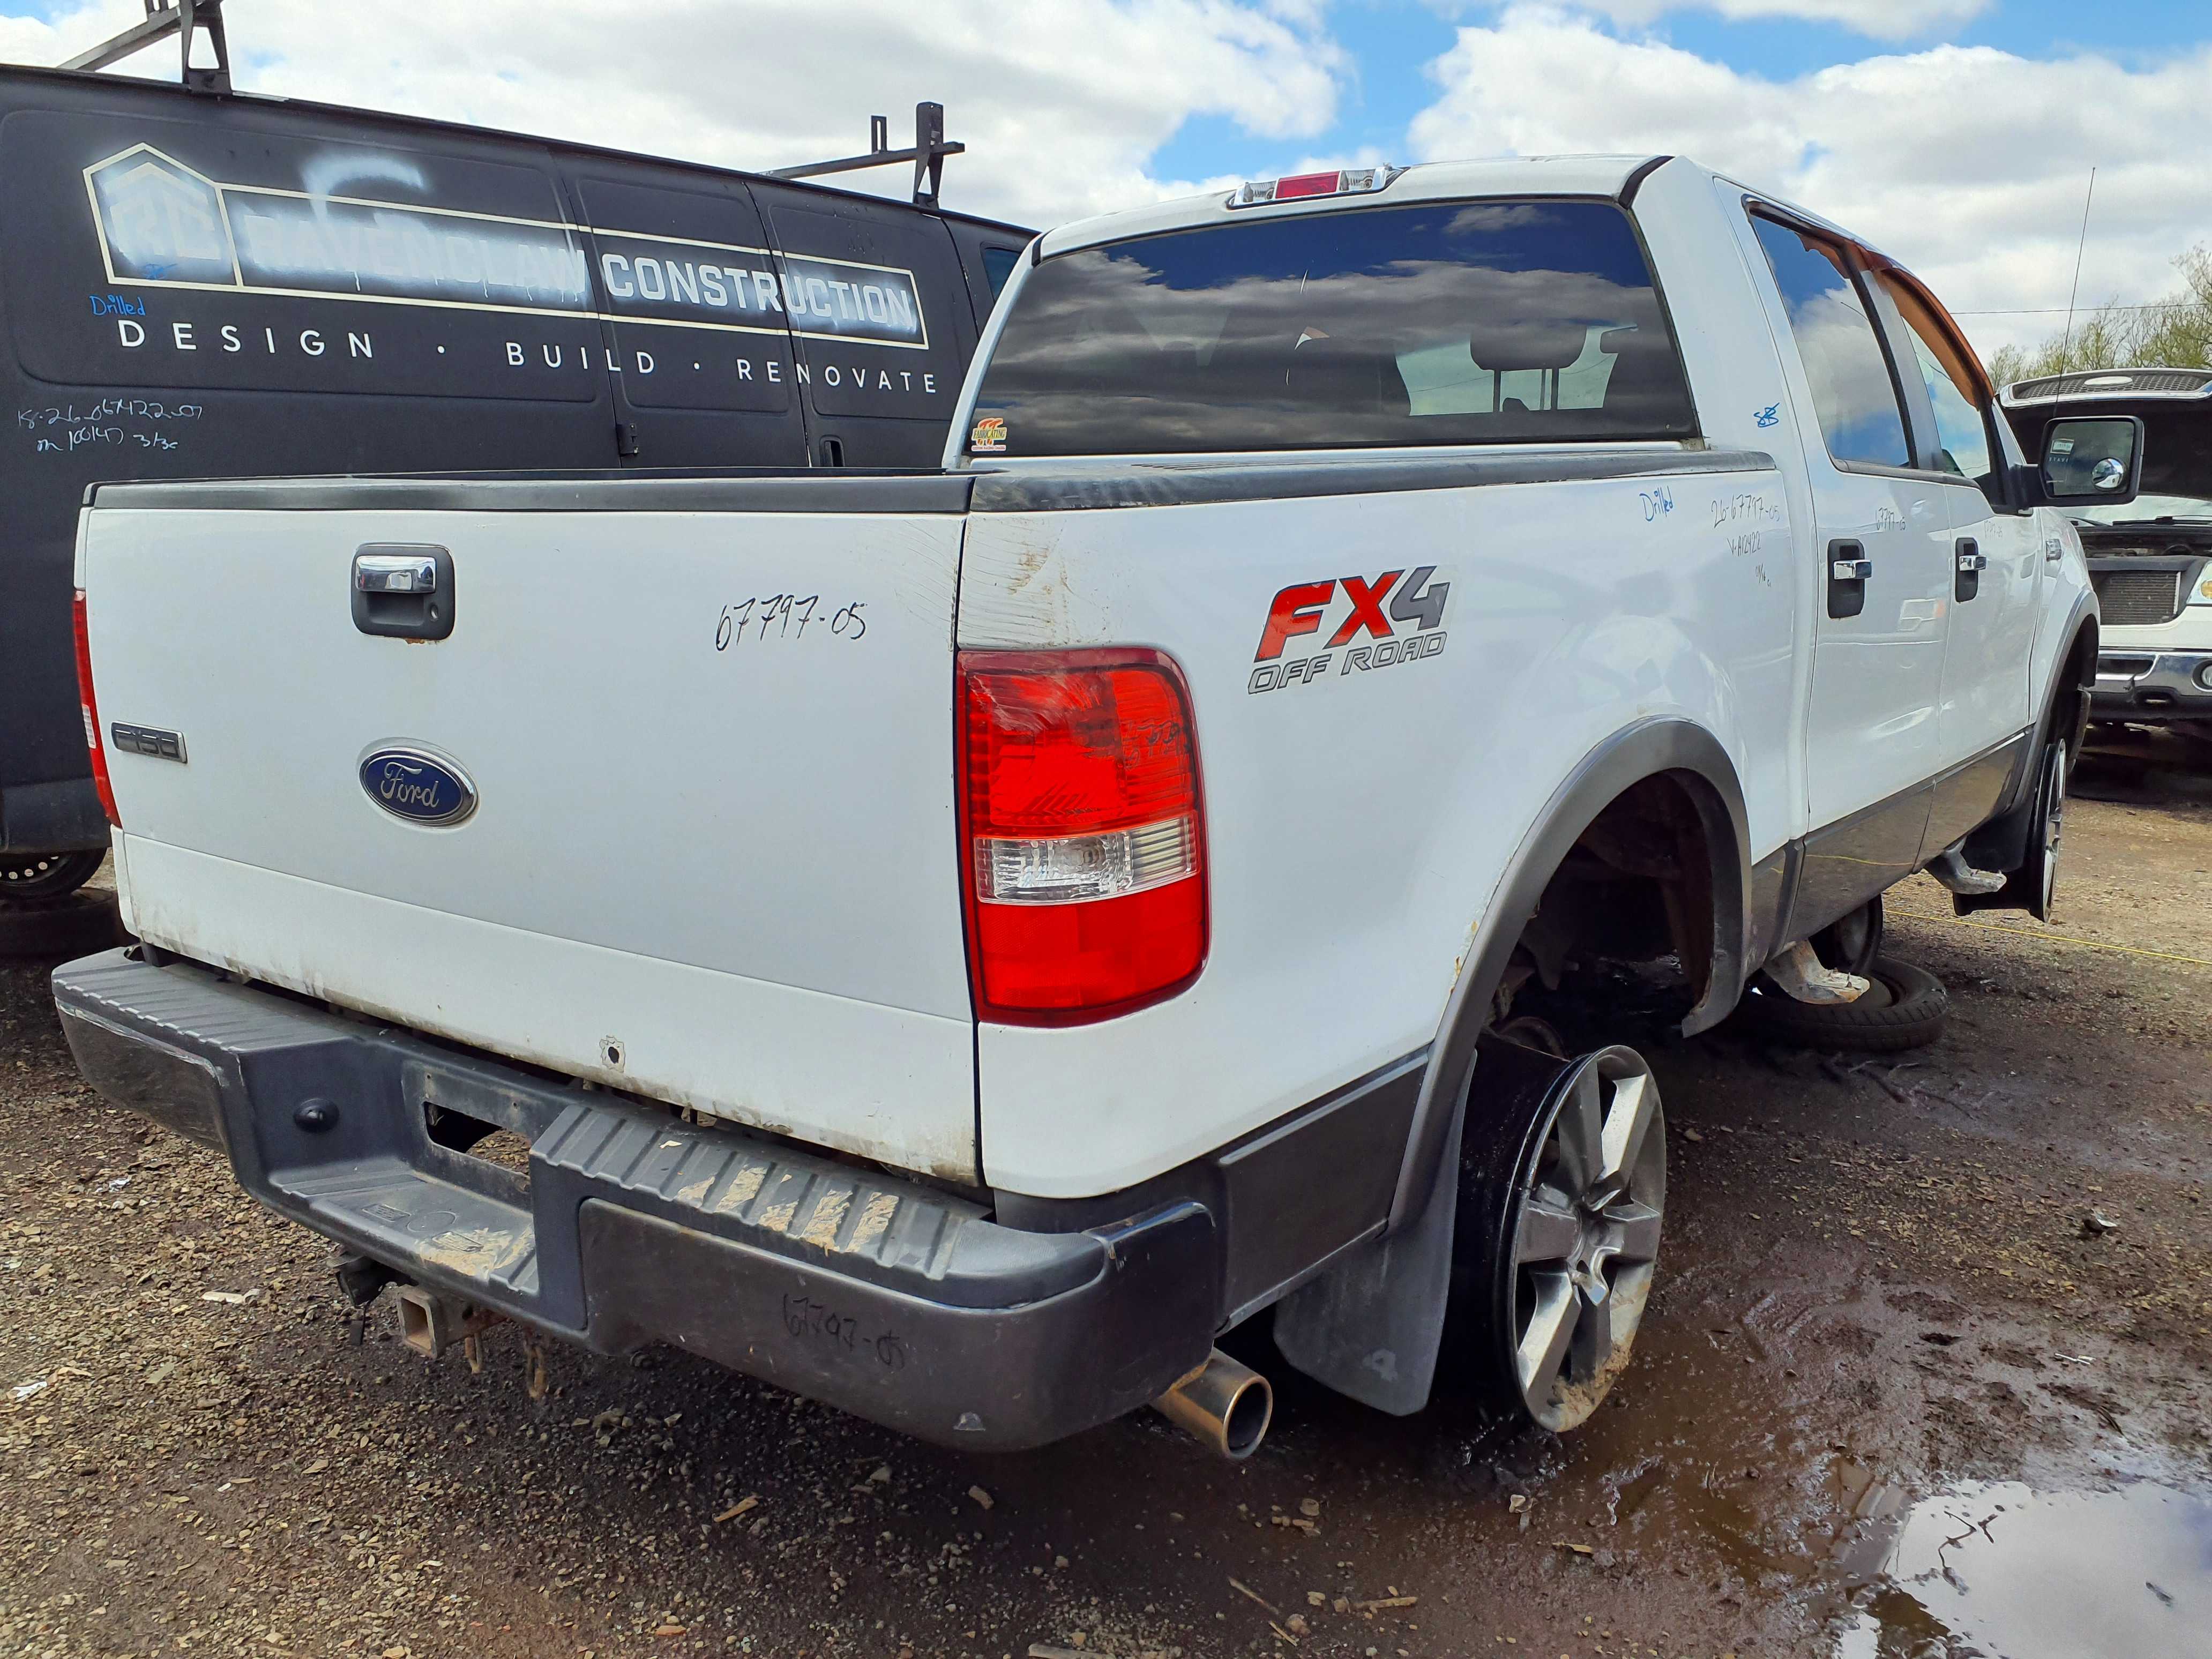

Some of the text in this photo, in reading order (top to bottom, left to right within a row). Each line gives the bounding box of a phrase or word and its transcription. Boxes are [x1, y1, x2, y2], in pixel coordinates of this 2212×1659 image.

[89, 294, 146, 316] Drilled
[602, 253, 917, 327] CONSTRUCTION
[118, 319, 937, 393] DESIGN BUILD RENOVATE
[715, 593, 868, 652] 67797-05
[1253, 565, 1451, 664] FX4
[1247, 631, 1448, 696] OFF ROAD
[380, 761, 439, 808] Ford
